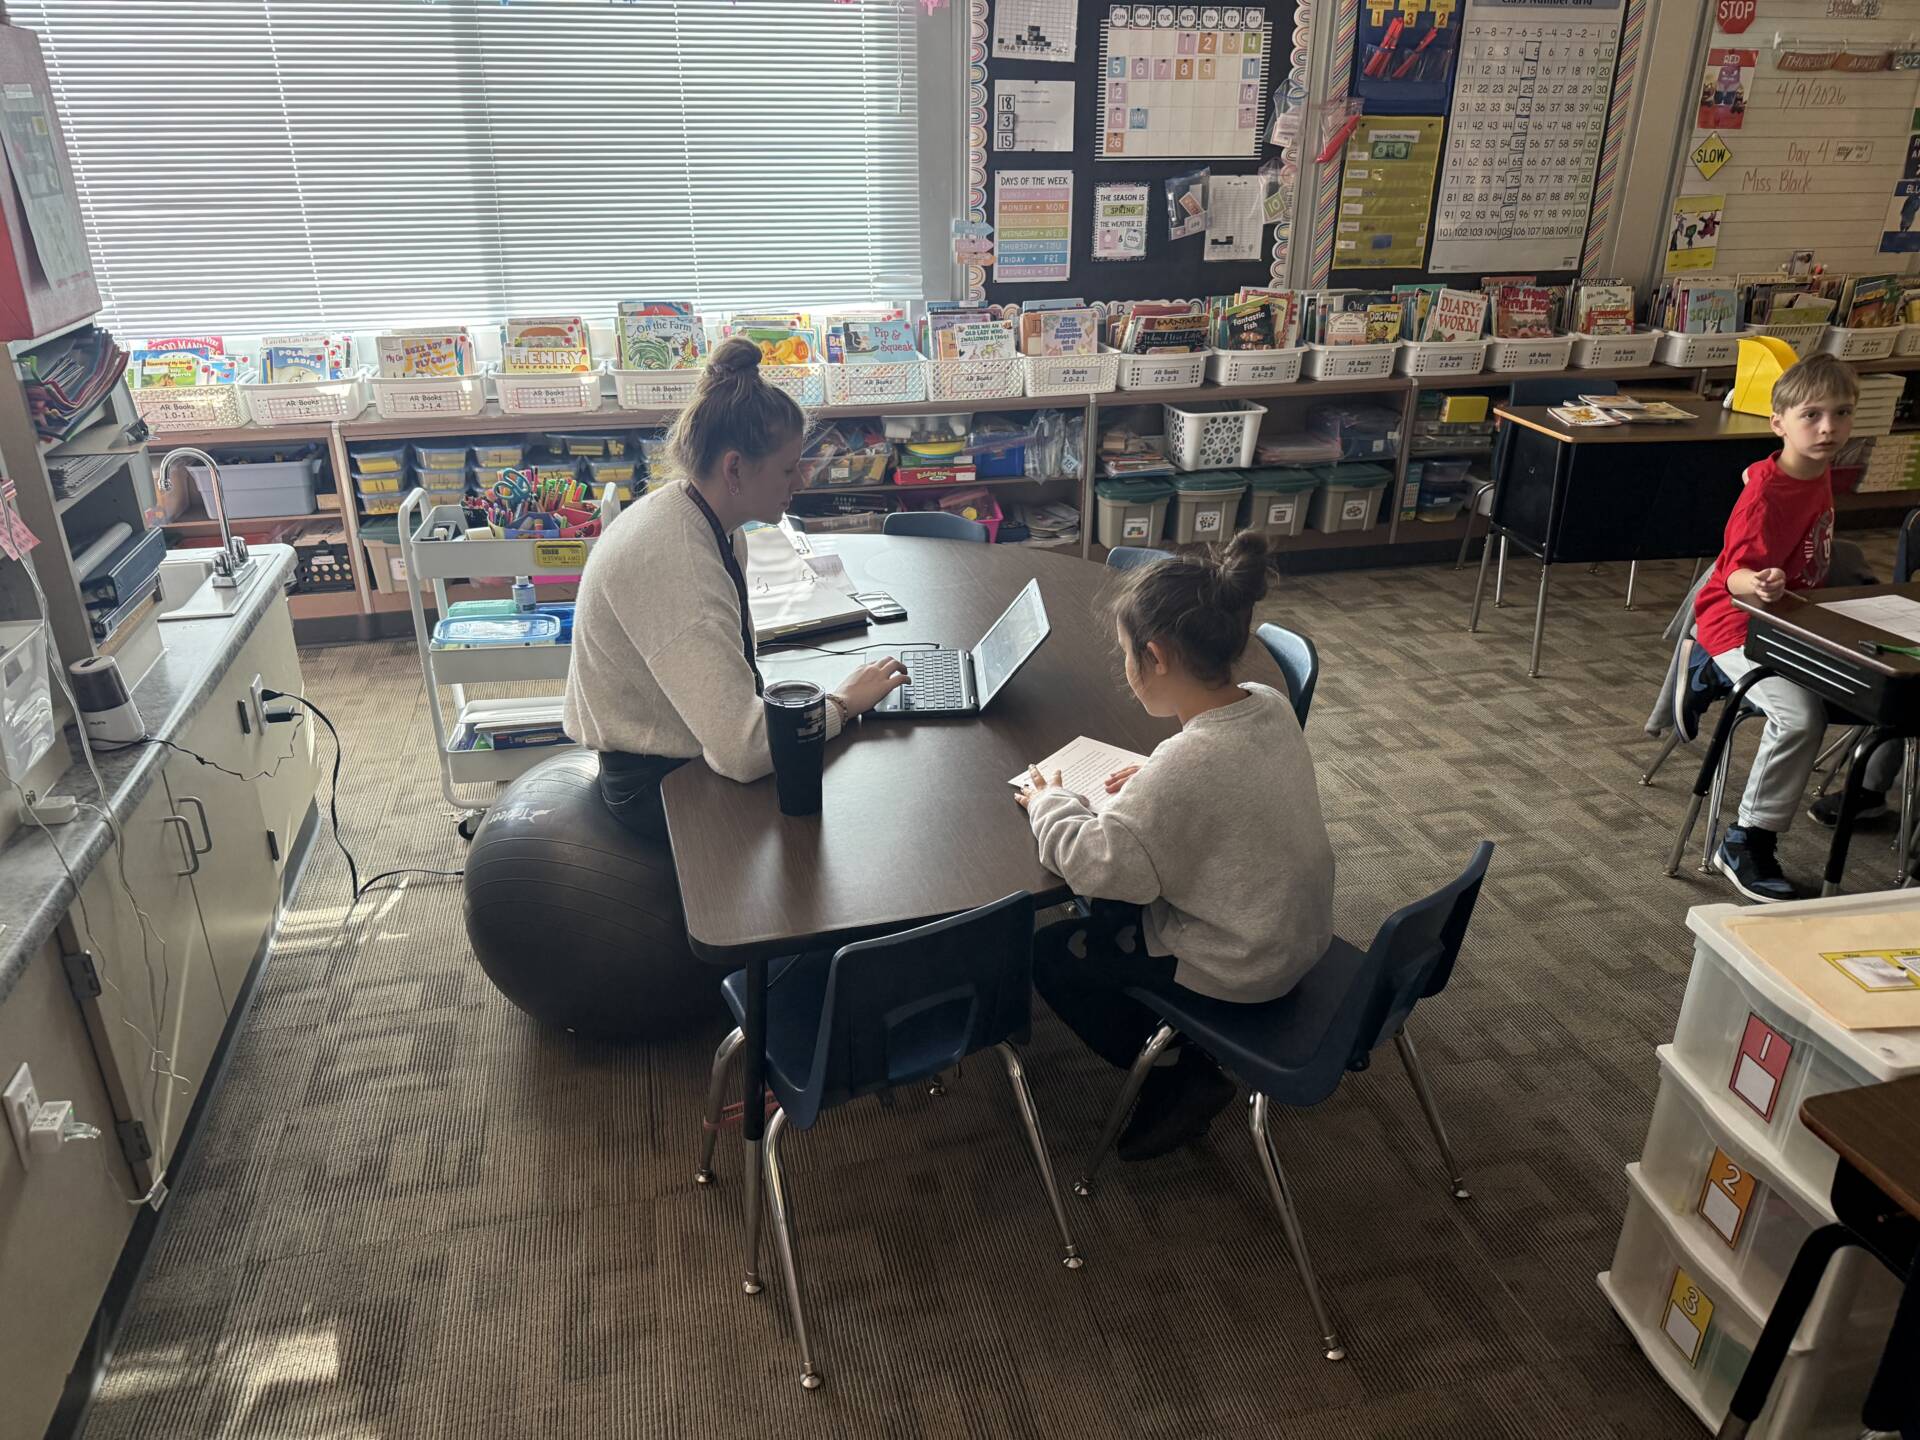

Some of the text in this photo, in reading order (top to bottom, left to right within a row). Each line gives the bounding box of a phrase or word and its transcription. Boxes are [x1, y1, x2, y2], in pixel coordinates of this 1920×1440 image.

[1720, 1, 1754, 19] STOP
[1114, 12, 1126, 21] SUN
[1137, 12, 1149, 20] MON
[1160, 12, 1171, 21] TUE
[1181, 13, 1194, 21] WED
[1205, 14, 1216, 22] THU
[1375, 12, 1381, 24] 1
[1406, 12, 1414, 25] 3
[1438, 12, 1446, 25] 2
[1469, 27, 1616, 39] -9 -8 -7 -6 -5 -4 -3 -2 -1 0
[1184, 38, 1255, 51] 1 2 3 4
[1724, 55, 1741, 64] RED
[1113, 61, 1255, 75] 5 6 7 8 9 11
[1467, 65, 1609, 76] 11 12 13 14 15 16 17 18 19 20
[1111, 88, 1254, 100] 12 18
[1462, 84, 1607, 94] 21 22 23 24 25 26 27 28 29 30
[1776, 78, 1847, 111] 4/9/2026
[1002, 97, 1012, 110] 18
[1004, 116, 1010, 128] 3
[1111, 114, 1122, 124] 19
[1002, 136, 1012, 148] 15
[1109, 138, 1121, 149] 26
[1696, 149, 1726, 164] SLOW
[1787, 141, 1810, 165] Day
[1818, 140, 1829, 162] 4
[1000, 176, 1069, 186] DAYS OF THE WEEK
[1742, 168, 1771, 192] Miss
[1268, 202, 1280, 213] 10
[1044, 255, 1059, 263] FRI
[1440, 297, 1479, 317] DIARY
[1233, 312, 1266, 326] Fantastic
[1370, 312, 1383, 323] DOG
[1439, 313, 1479, 333] WORM
[636, 320, 693, 333] On the Farm
[1243, 322, 1258, 330] Fish
[873, 327, 902, 341] Pip &
[880, 340, 914, 355] Squeak
[287, 358, 321, 368] BABIES
[415, 358, 430, 368] FLY
[511, 351, 582, 364] HENRY
[1760, 1032, 1771, 1059] 1
[1722, 1164, 1741, 1194] 2
[1683, 1287, 1699, 1314] 3
